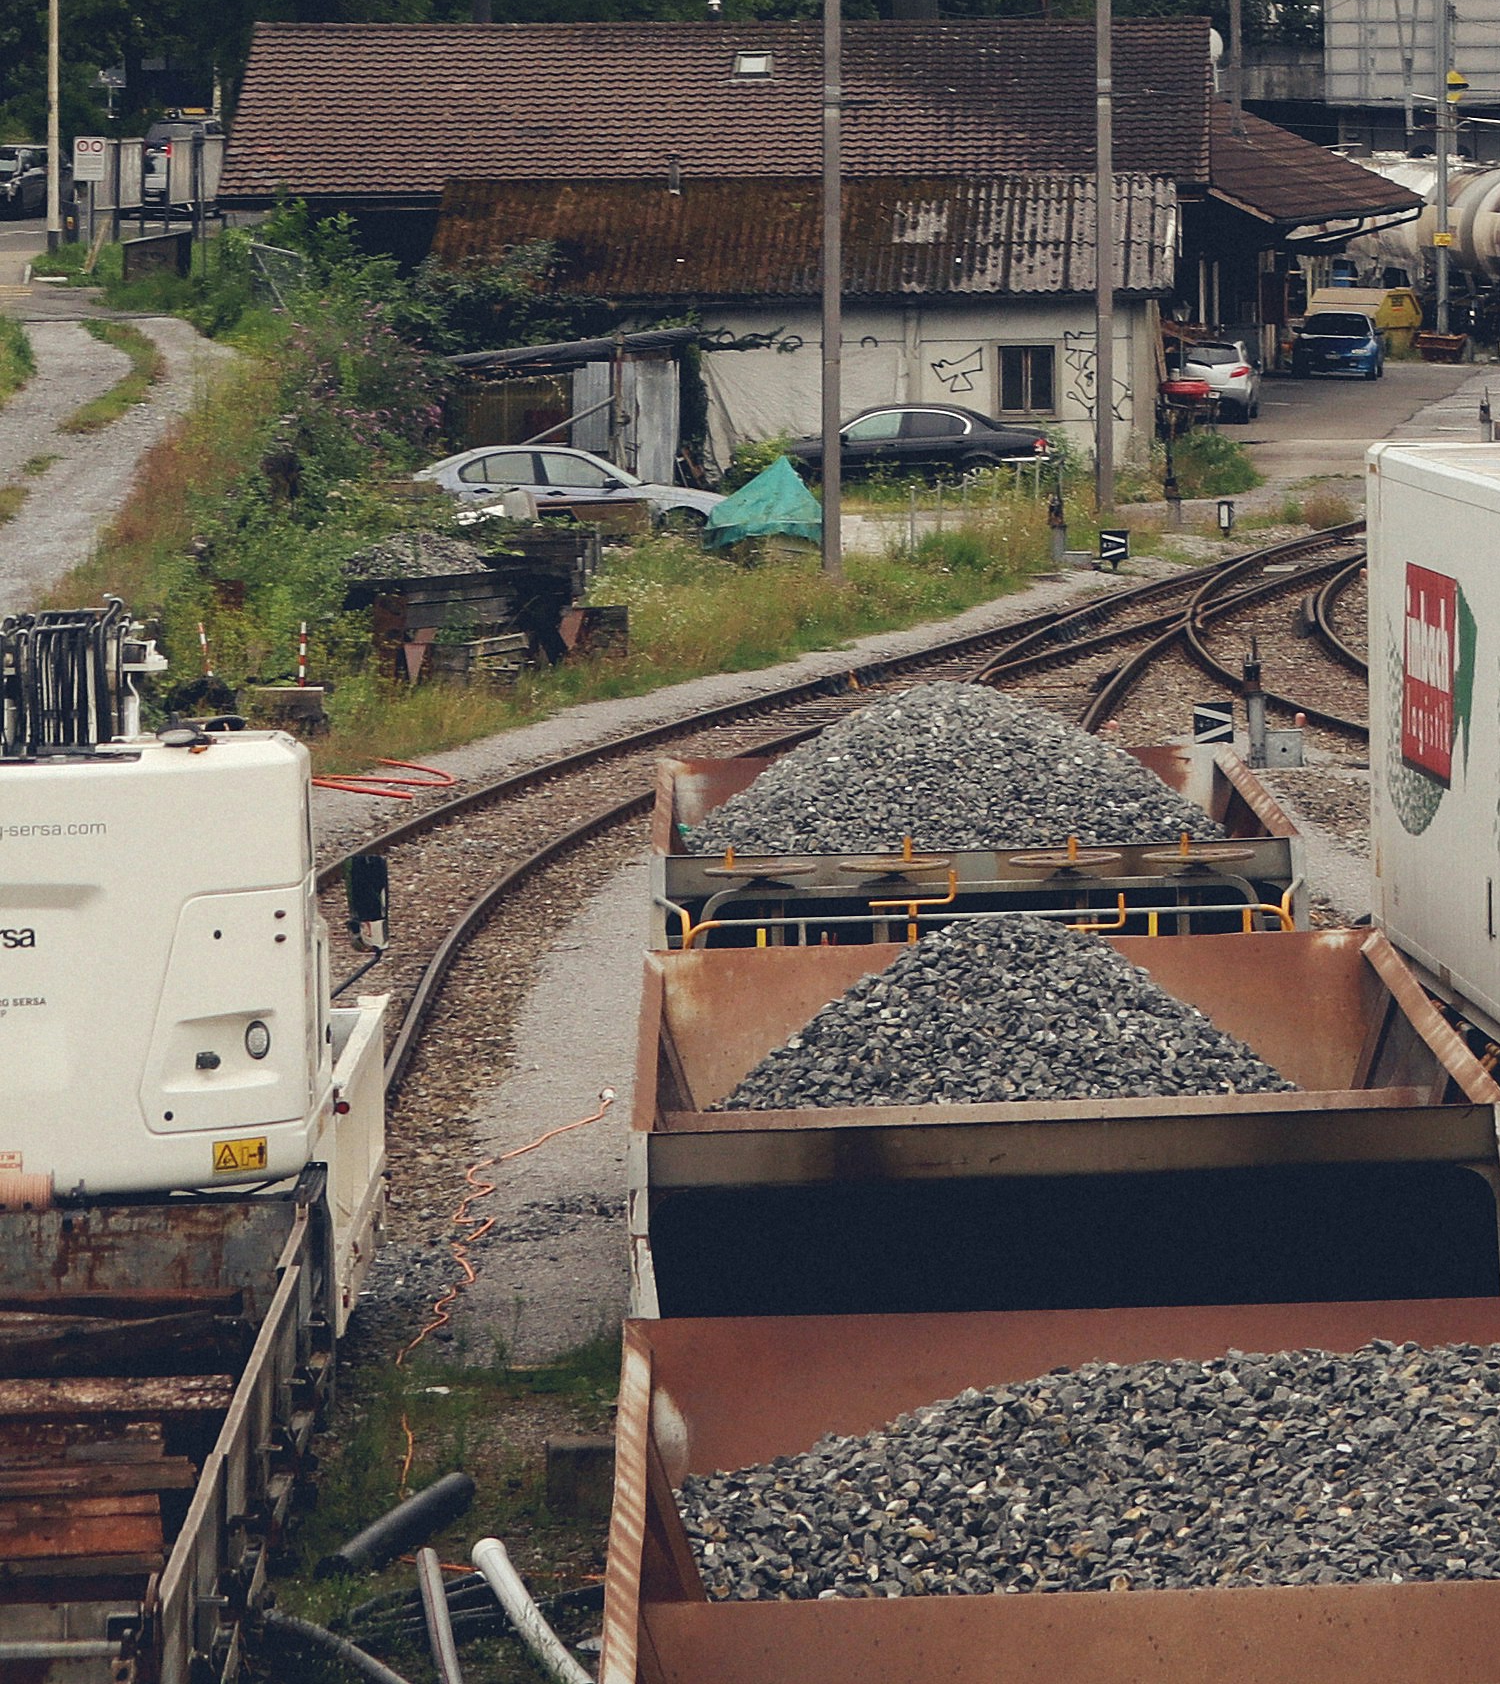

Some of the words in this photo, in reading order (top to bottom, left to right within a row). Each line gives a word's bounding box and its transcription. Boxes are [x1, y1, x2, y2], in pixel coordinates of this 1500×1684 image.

[1405, 584, 1450, 696] imbach
[1406, 681, 1451, 756] logistik
[13, 997, 47, 1007] SERSA
